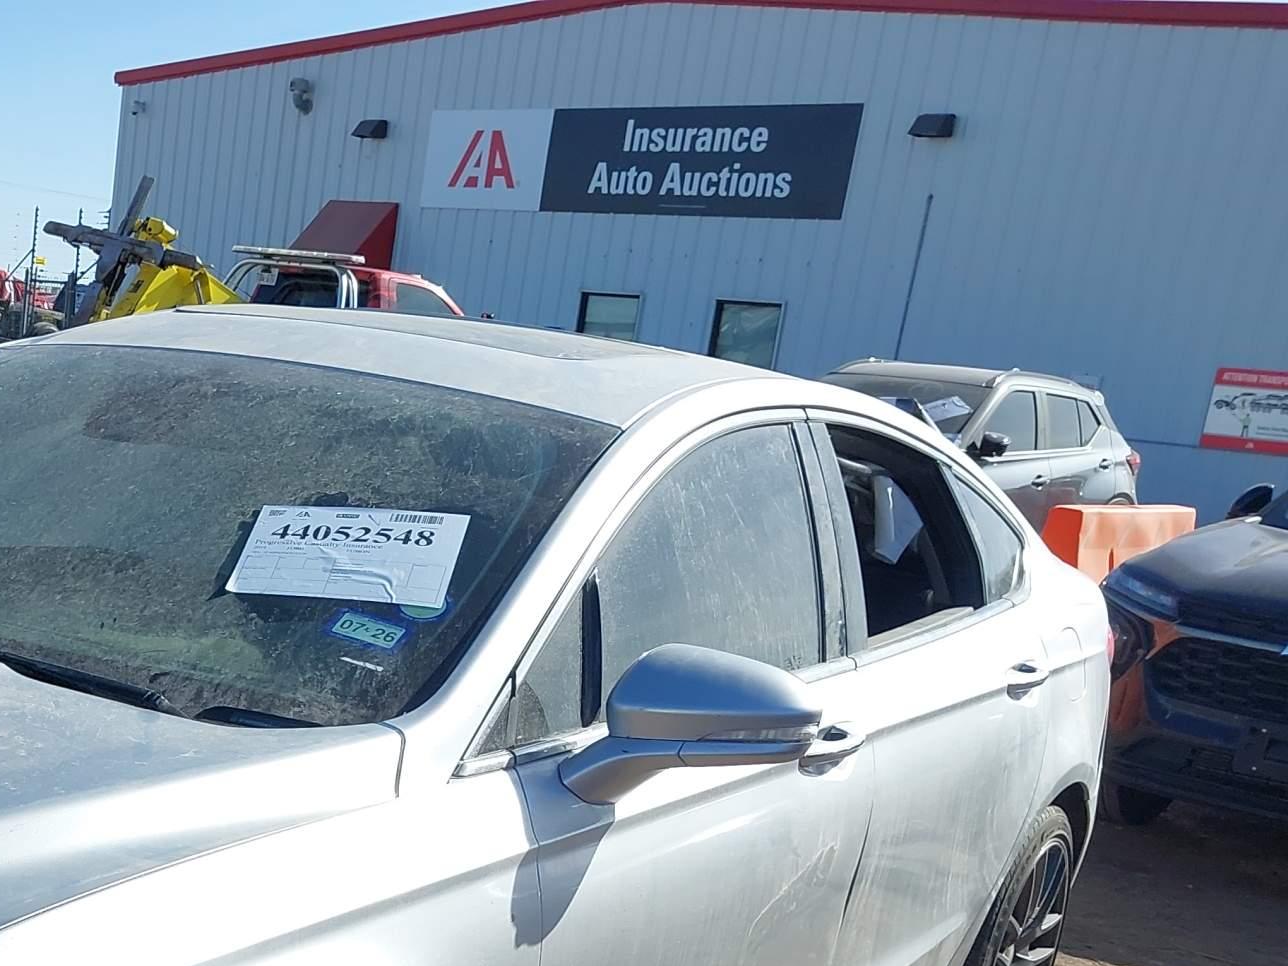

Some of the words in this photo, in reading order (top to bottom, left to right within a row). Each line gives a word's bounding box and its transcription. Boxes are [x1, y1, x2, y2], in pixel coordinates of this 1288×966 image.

[623, 119, 768, 153] Insurance
[587, 162, 653, 195] Auto
[659, 163, 792, 198] Auctions
[271, 523, 435, 547] 44052548
